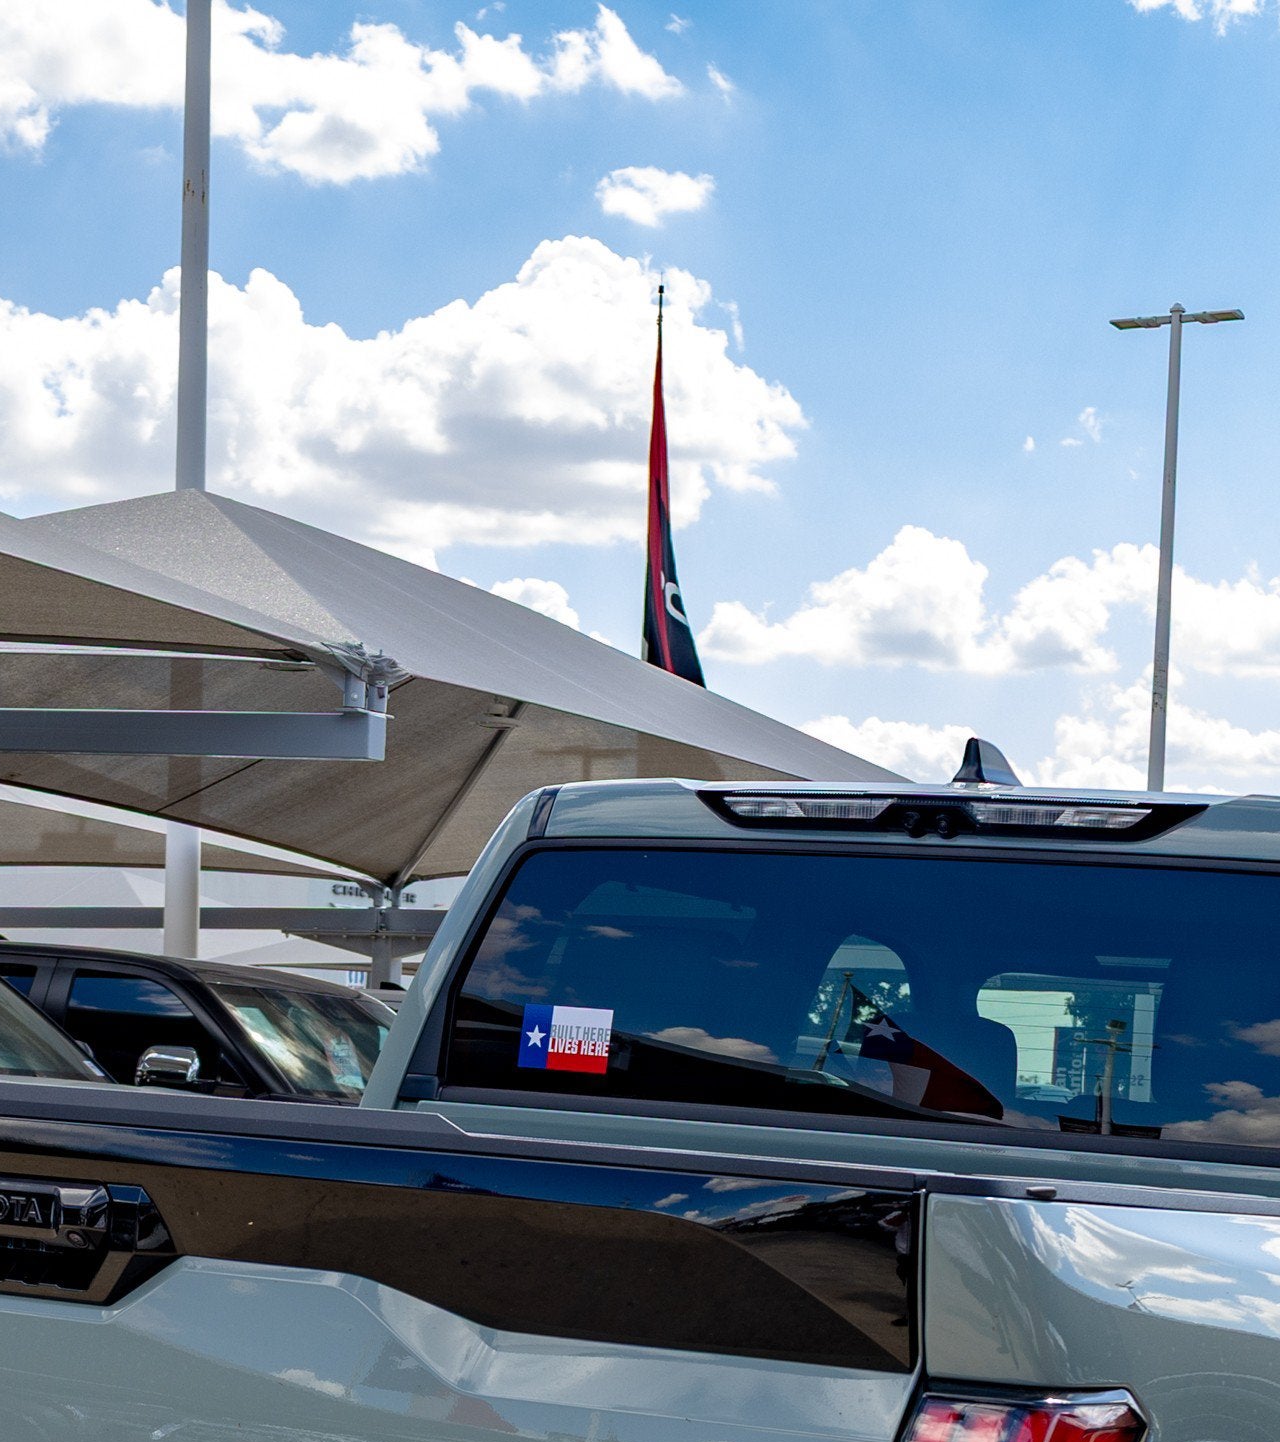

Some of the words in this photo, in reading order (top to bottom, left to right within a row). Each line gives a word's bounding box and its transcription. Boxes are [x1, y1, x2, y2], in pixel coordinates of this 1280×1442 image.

[551, 1024, 581, 1041] BUILT
[583, 1026, 611, 1043] HERE
[548, 1037, 578, 1055] LIVES
[580, 1039, 609, 1057] HERE
